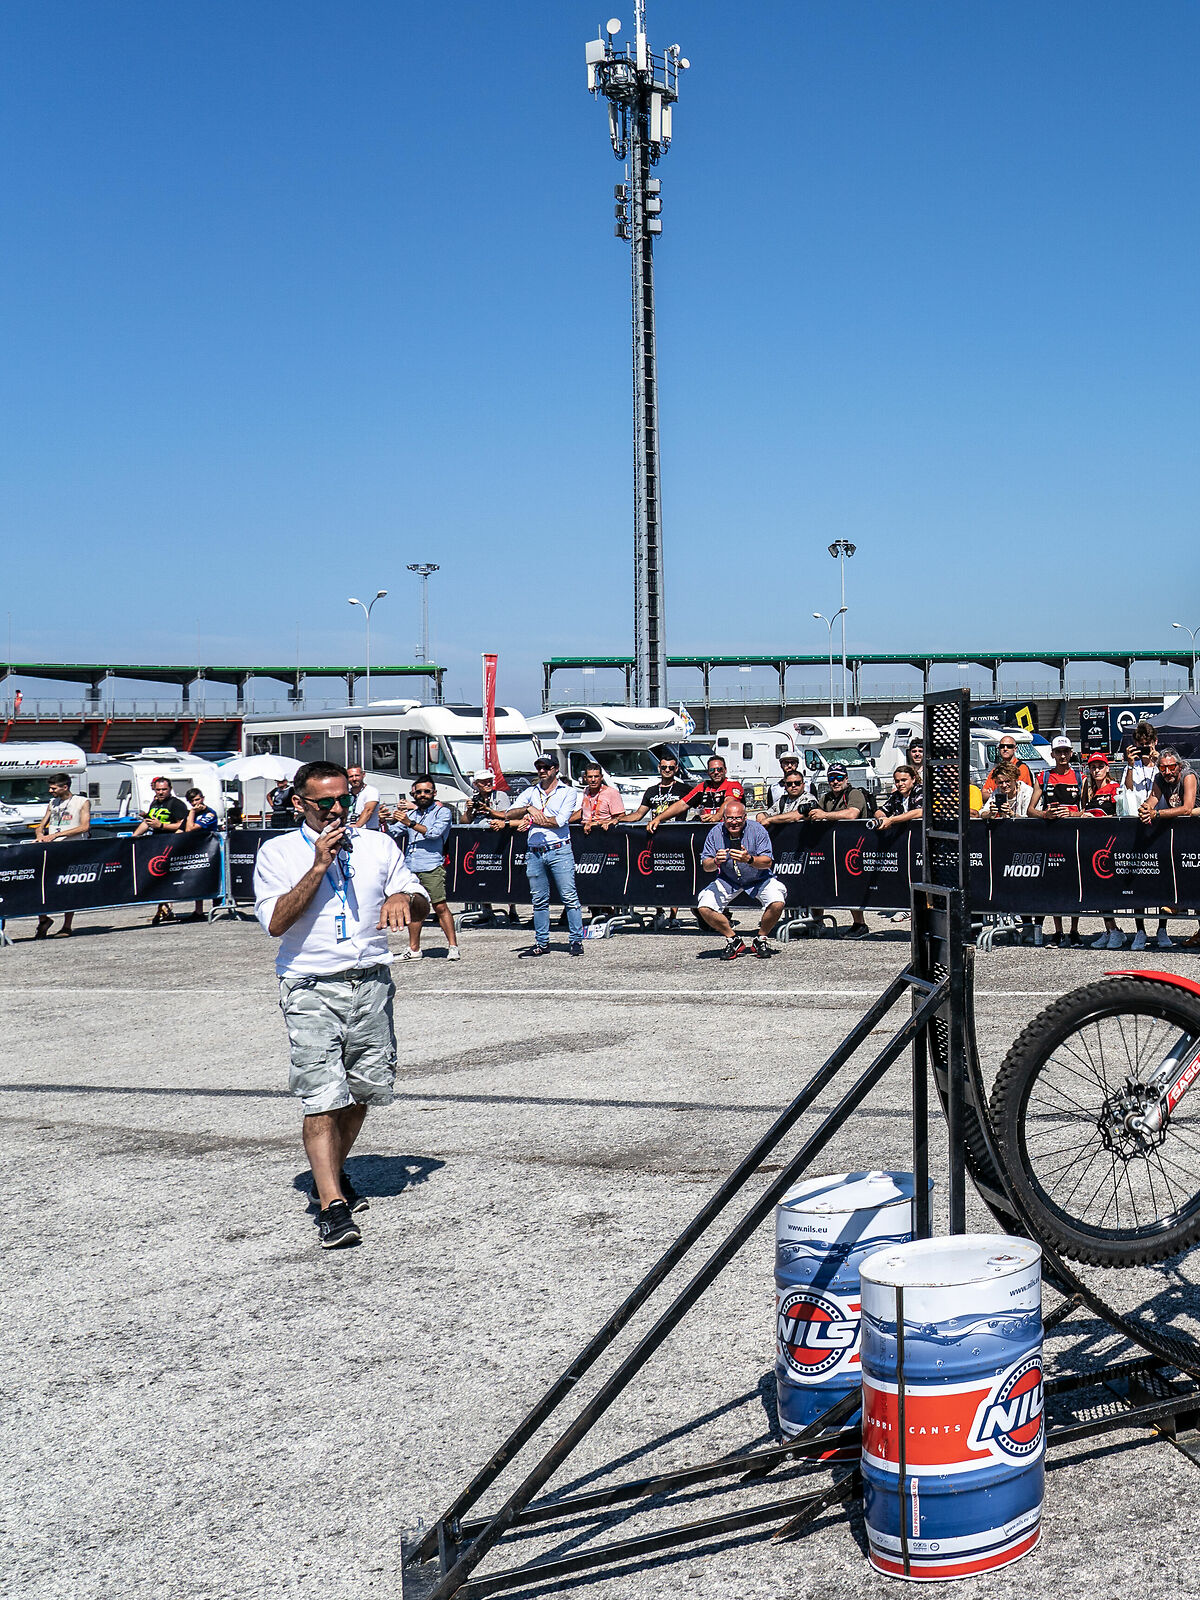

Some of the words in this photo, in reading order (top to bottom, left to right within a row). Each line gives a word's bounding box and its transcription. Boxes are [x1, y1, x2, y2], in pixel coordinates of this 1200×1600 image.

[773, 863, 802, 874] MOOD
[1003, 865, 1041, 877] MOOD
[56, 873, 97, 886] MOOD
[787, 1223, 828, 1234] www.nils.eu
[778, 1313, 859, 1350] NILS
[867, 1415, 892, 1431] LUBRI
[909, 1424, 961, 1435] CANTS
